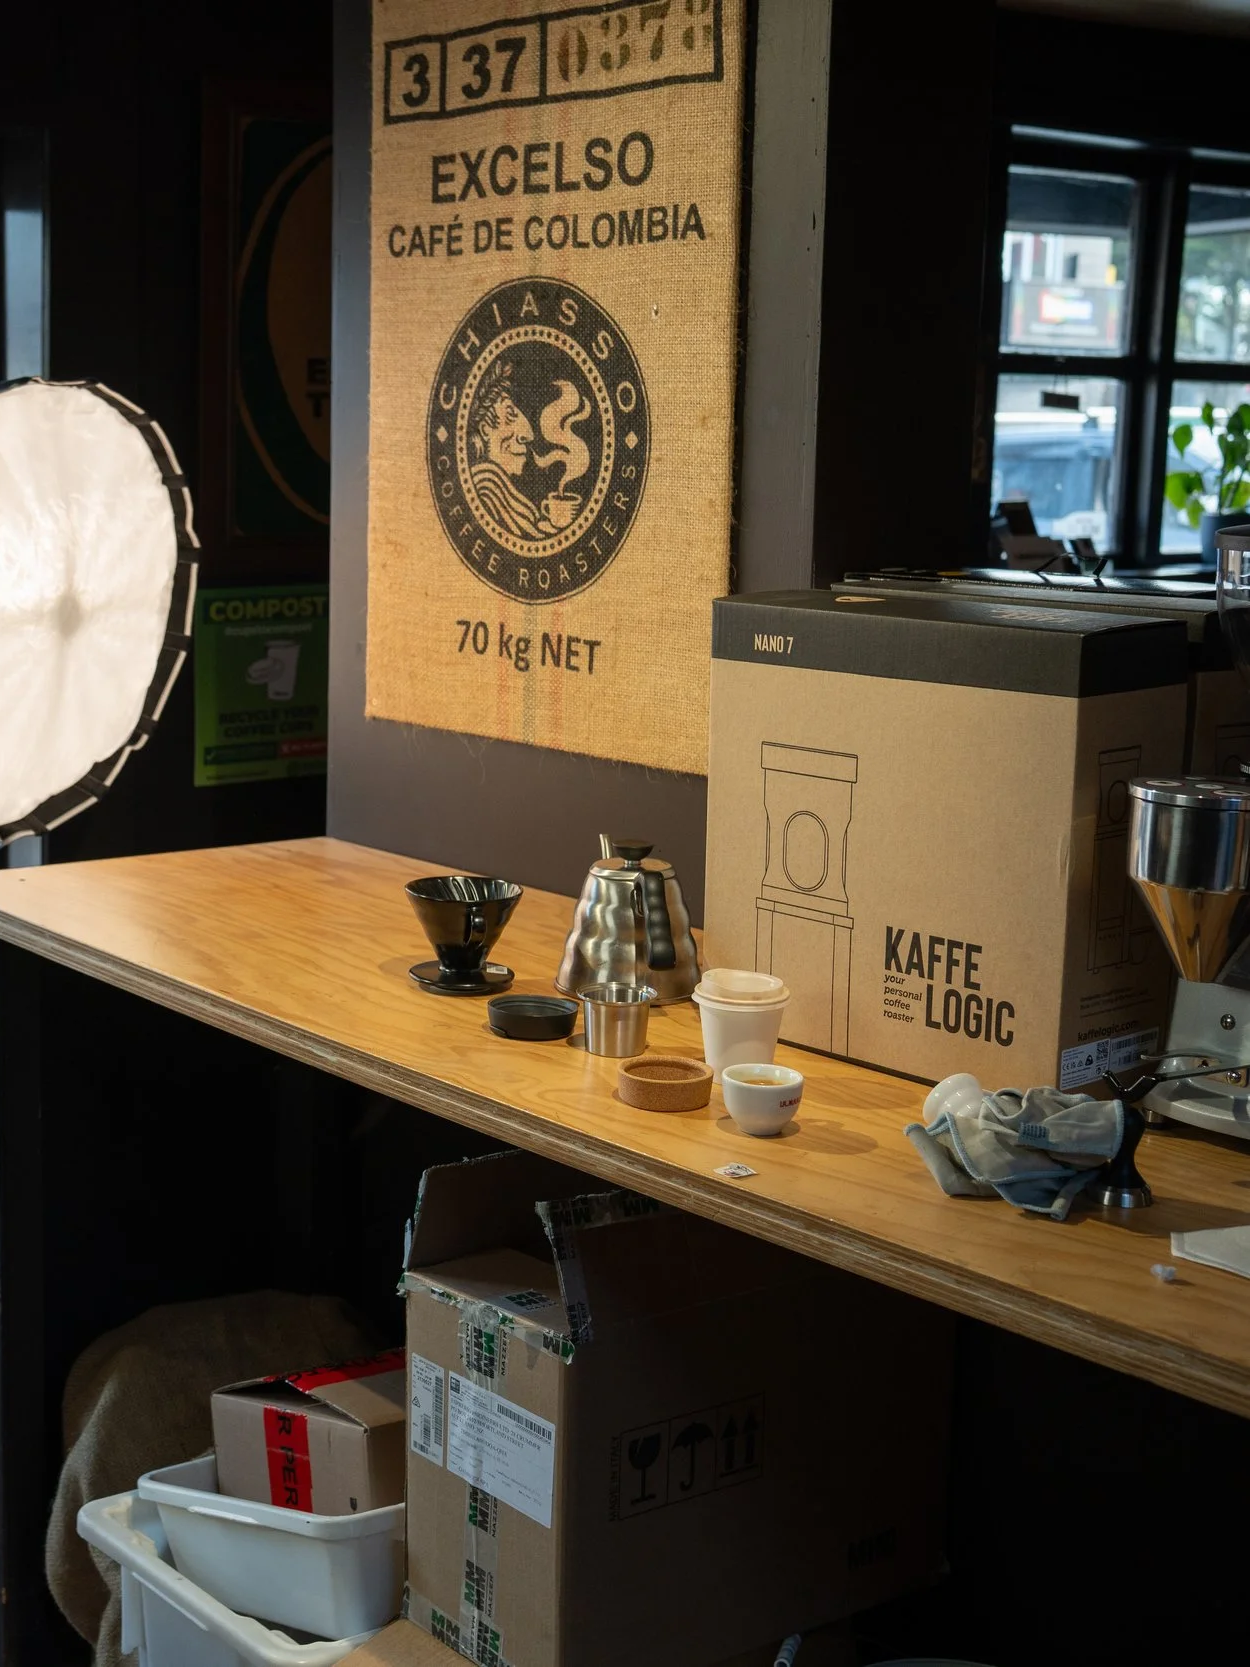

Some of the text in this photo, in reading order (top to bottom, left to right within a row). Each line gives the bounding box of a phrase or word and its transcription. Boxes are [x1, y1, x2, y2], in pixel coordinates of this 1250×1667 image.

[402, 53, 431, 108] 3
[461, 36, 527, 100] 37
[431, 131, 654, 204] EXCELSO
[388, 203, 706, 258] CAFÉ DE COLOMBIA
[438, 291, 637, 414] CHIASSO
[435, 455, 637, 591] COFFEE ROASTERS
[209, 597, 327, 622] COMPOST
[455, 619, 602, 675] 70 kg NET
[754, 633, 794, 655] NANO 7
[884, 925, 983, 991] KAFFE
[884, 973, 906, 986] your
[884, 986, 923, 1003] personal
[884, 999, 910, 1012] coffee
[884, 1010, 914, 1024] roaster
[925, 984, 1016, 1047] LOGIC
